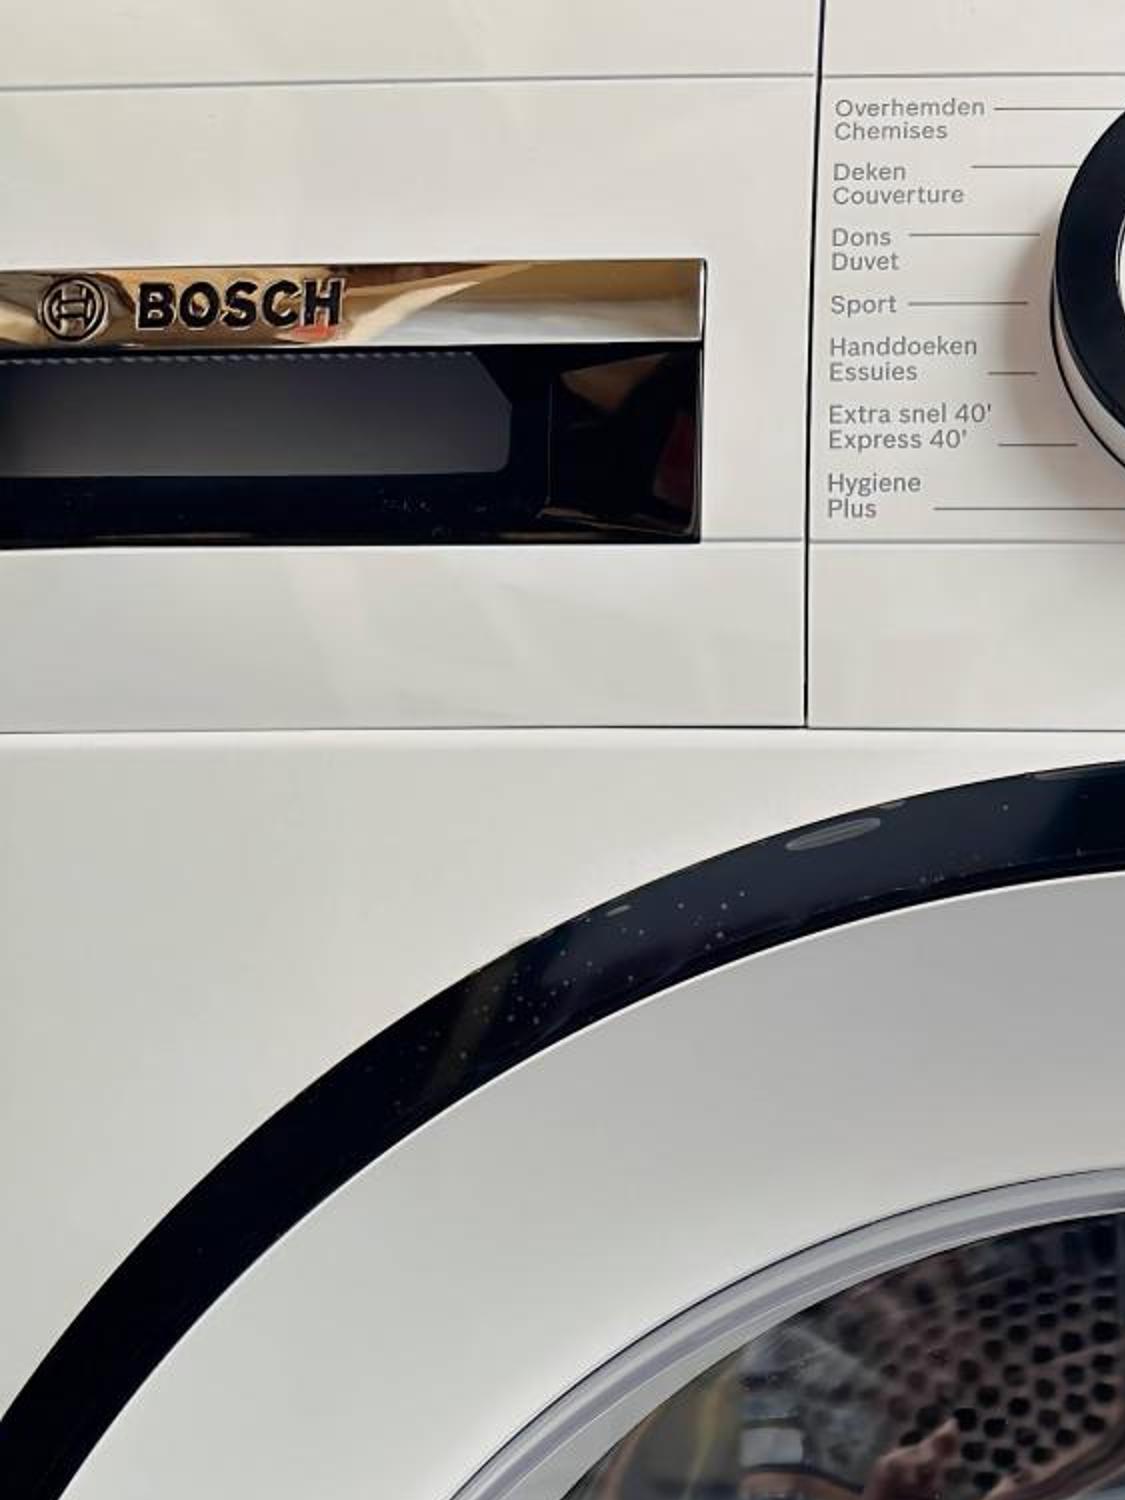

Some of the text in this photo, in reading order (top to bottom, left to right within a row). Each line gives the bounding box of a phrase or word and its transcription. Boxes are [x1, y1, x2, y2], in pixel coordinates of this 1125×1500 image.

[834, 98, 986, 117] Overhemden
[834, 121, 948, 141] Chemises
[833, 162, 907, 181] Deken
[832, 185, 965, 206] Couverture
[831, 228, 892, 247] Dons
[830, 252, 900, 271] Duvet
[136, 277, 346, 331] BOSCH
[830, 295, 897, 317] Sport
[829, 336, 978, 357] Handdoeken
[828, 363, 918, 382] Essuies
[828, 405, 890, 424] Extra
[899, 404, 947, 424] snel
[827, 430, 923, 452] Express
[827, 473, 922, 496] Hygiene
[827, 499, 877, 519] Plus
